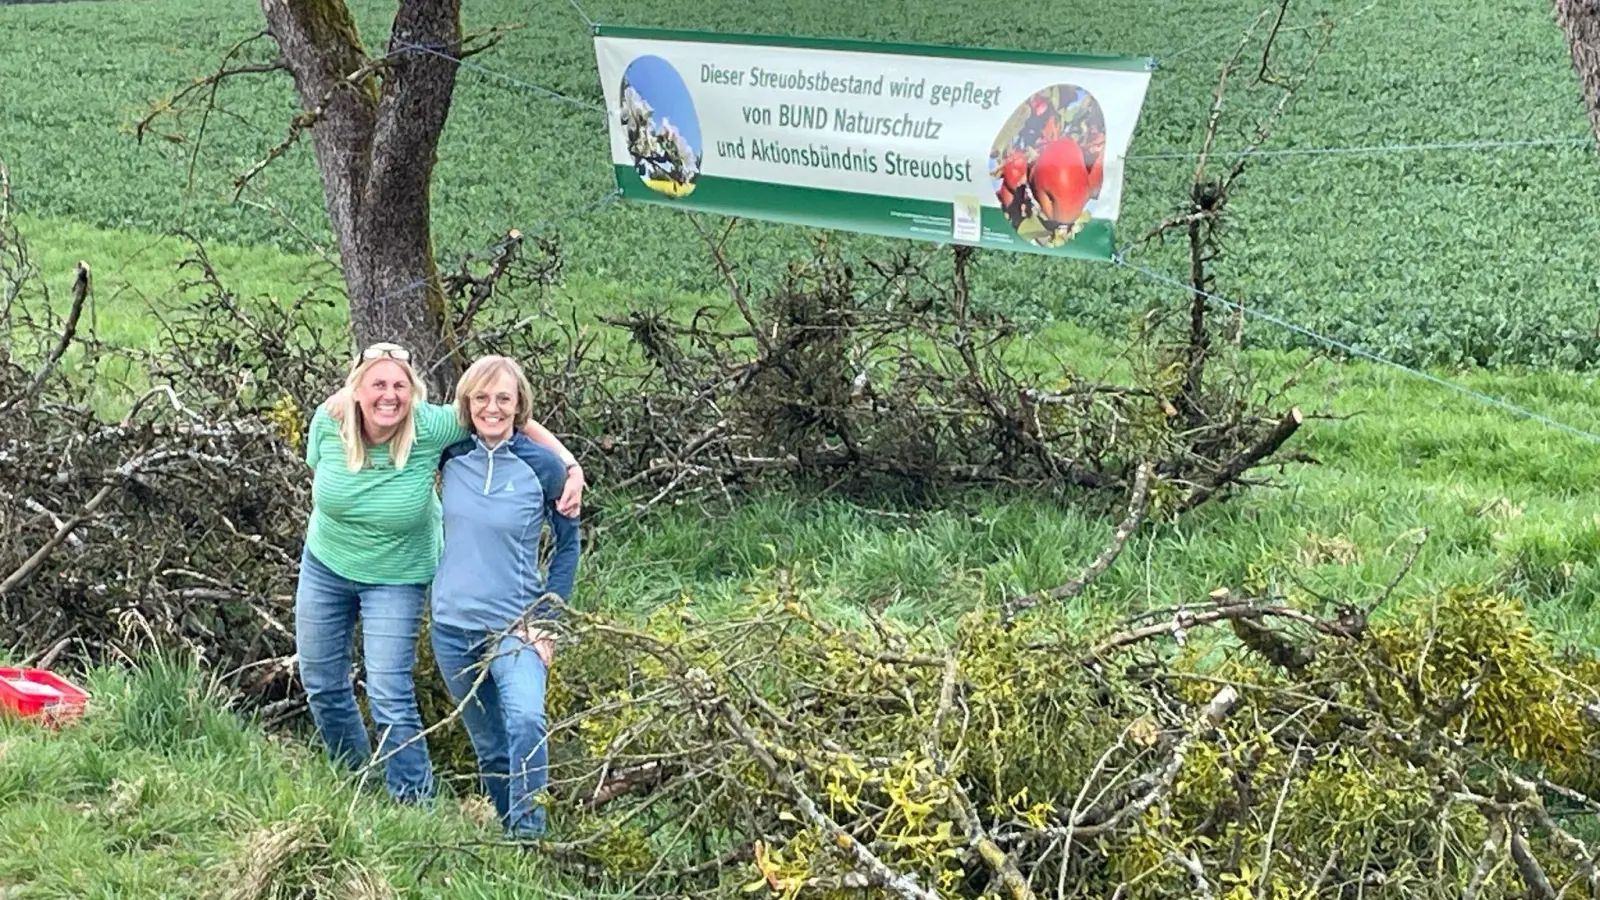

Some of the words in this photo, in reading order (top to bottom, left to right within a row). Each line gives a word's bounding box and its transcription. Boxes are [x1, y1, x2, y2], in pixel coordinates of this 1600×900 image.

[700, 63, 745, 86] Dieser
[749, 66, 884, 96] Streuobstbestand
[889, 76, 926, 99] wird
[930, 81, 1002, 110] gepflegt
[742, 106, 771, 125] von
[779, 104, 828, 129] BUND
[833, 108, 943, 140] Naturschutz
[716, 136, 745, 160] und
[751, 138, 878, 174] Aktionsbündnis
[884, 150, 972, 182] Streuobst
